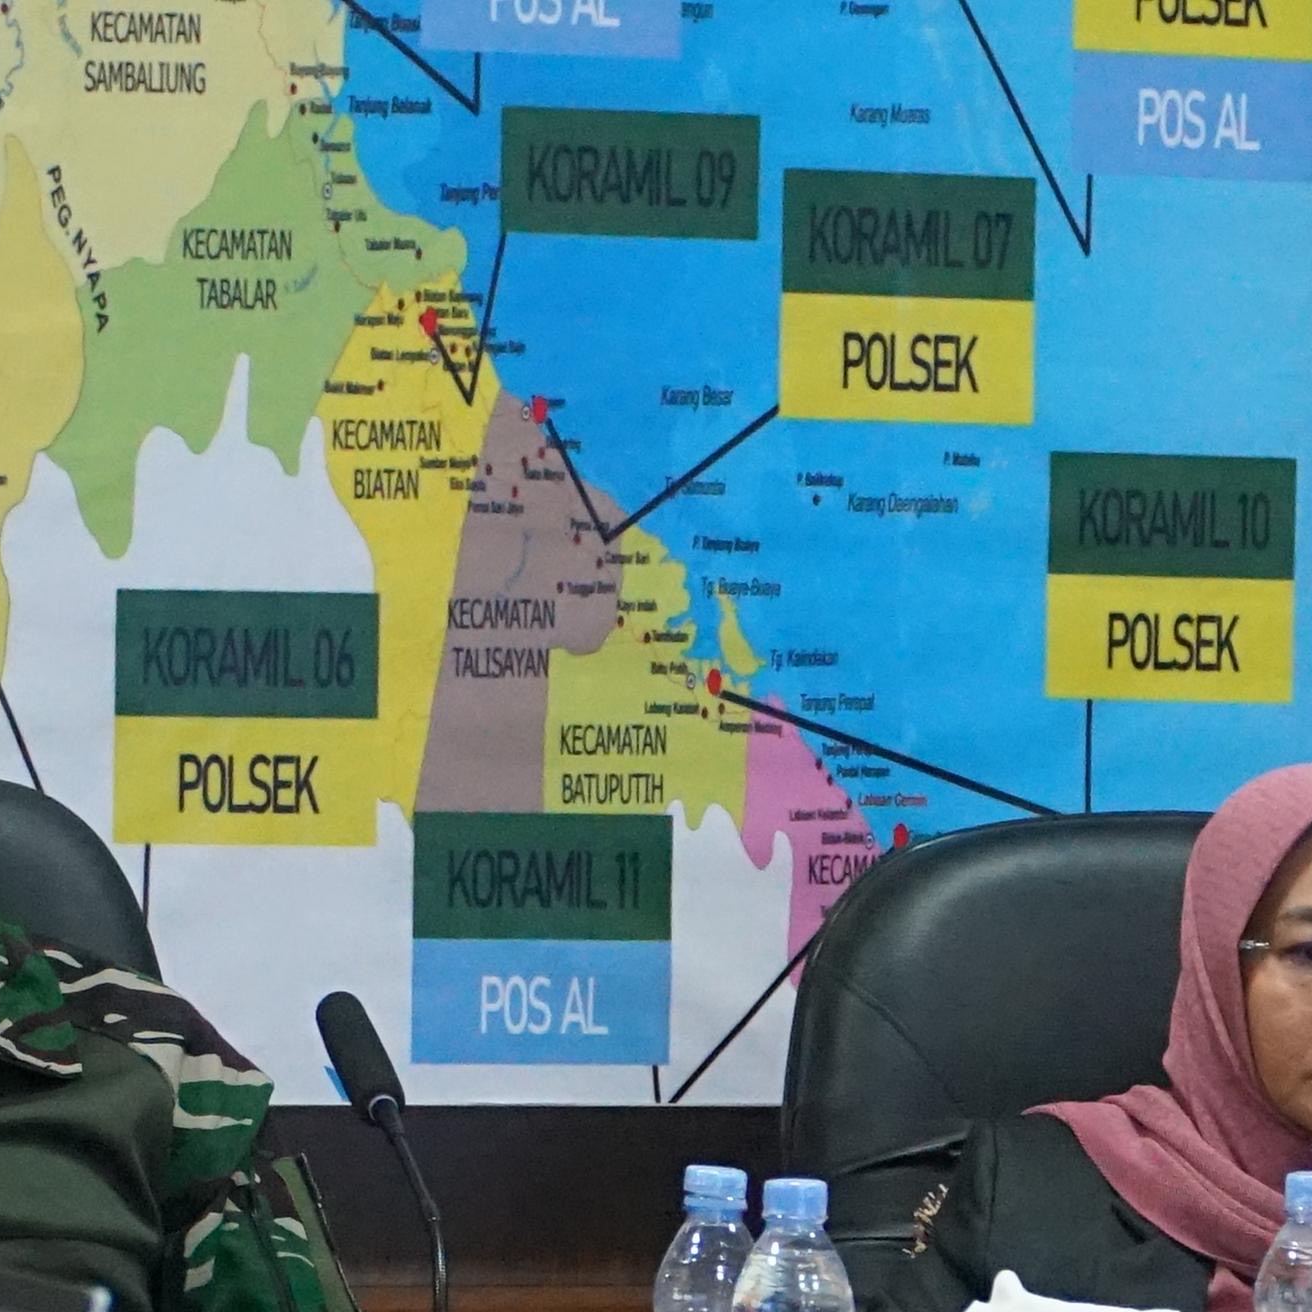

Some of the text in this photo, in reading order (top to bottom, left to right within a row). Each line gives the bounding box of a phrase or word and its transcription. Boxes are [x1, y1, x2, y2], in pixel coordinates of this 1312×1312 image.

[90, 11, 201, 43] KECAMATAN
[84, 61, 206, 93] SAMBALIUNG
[1139, 88, 1261, 151] POS AL
[527, 144, 736, 209] KORAMIL 09
[183, 228, 292, 260] KECAMATAN
[809, 206, 1013, 270] KORAMIL 07
[196, 278, 278, 310] TABALAR
[842, 332, 979, 394] POLSEK
[332, 419, 441, 451] KECAMATAN
[353, 469, 419, 500] BIATAN
[1078, 487, 1271, 550] KORAMIL 10
[448, 599, 555, 630] KECAMATAN
[142, 626, 356, 690] KORAMIL 06
[452, 648, 549, 679] TALISAYAN
[1108, 612, 1240, 673] POLSEK
[560, 725, 667, 755] KECAMATAN
[178, 753, 319, 814] POLSEK
[562, 774, 664, 805] BATUPUTIH
[447, 850, 642, 909] KORAMIL 11
[480, 976, 609, 1035] POS AL
